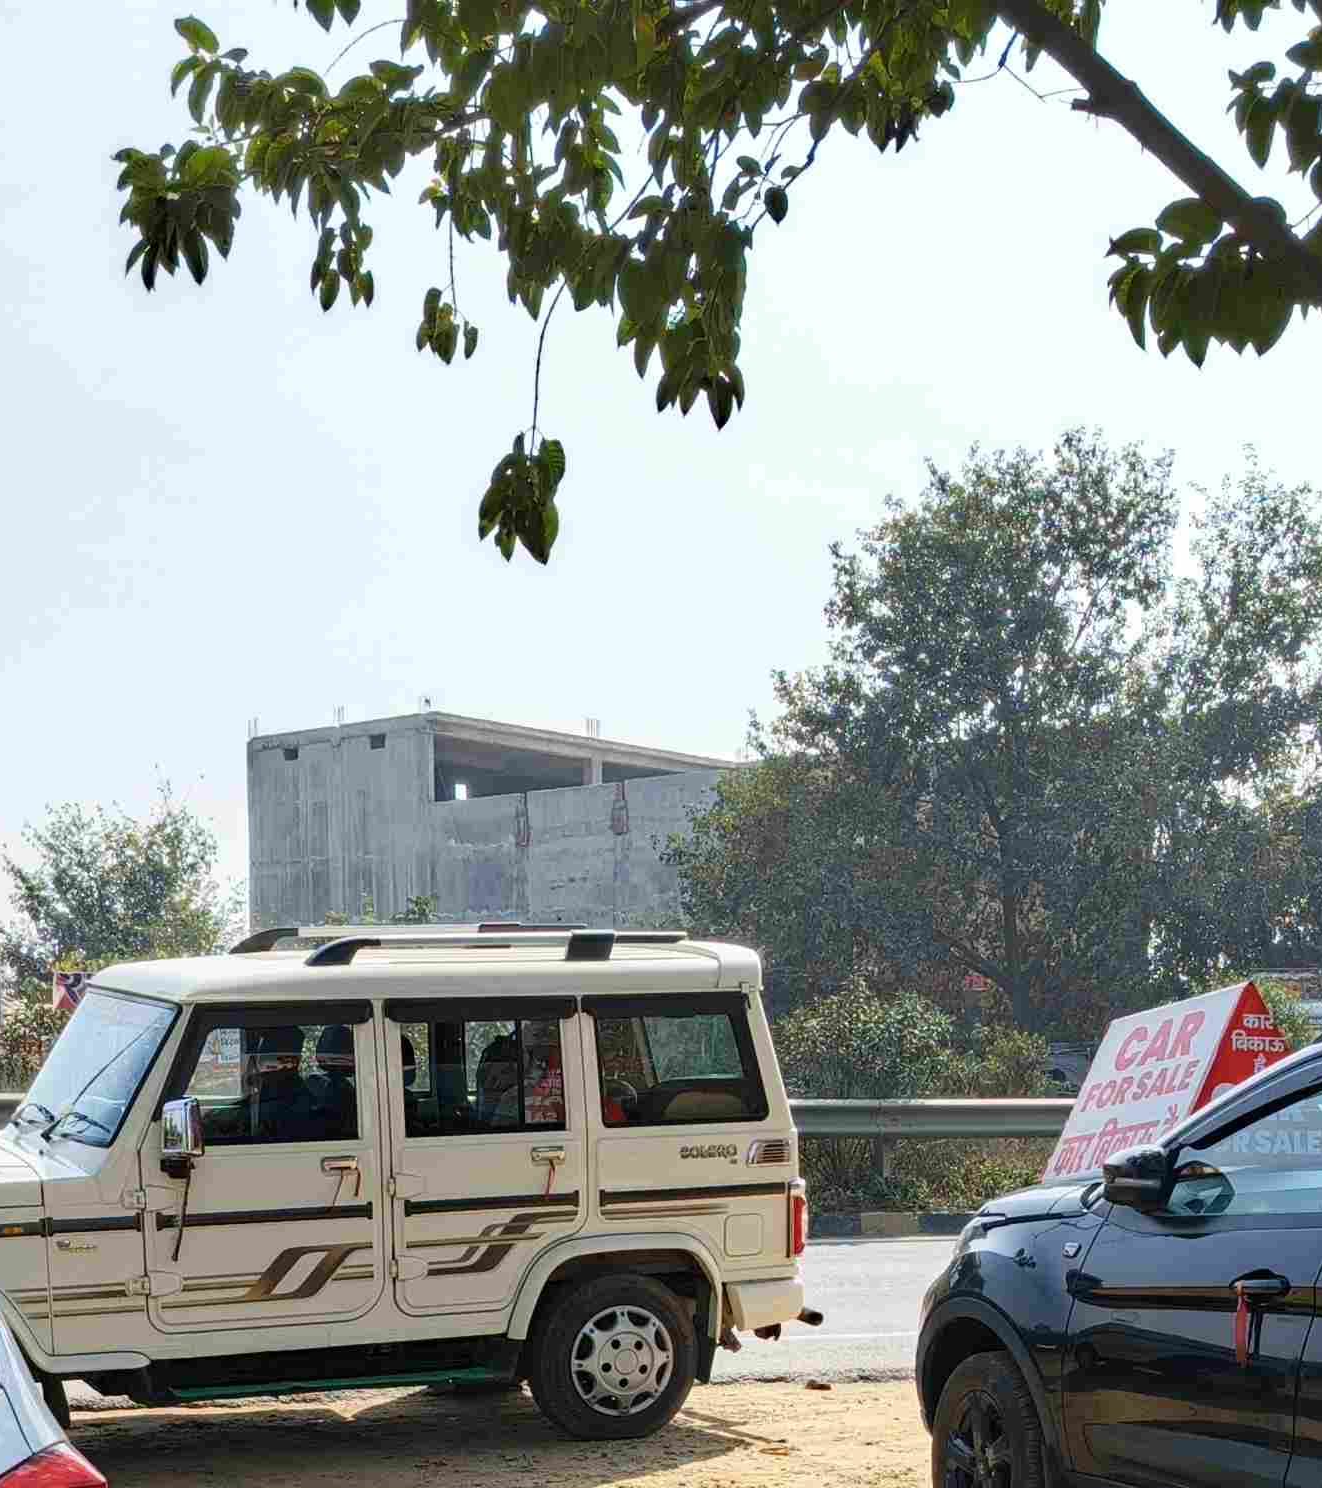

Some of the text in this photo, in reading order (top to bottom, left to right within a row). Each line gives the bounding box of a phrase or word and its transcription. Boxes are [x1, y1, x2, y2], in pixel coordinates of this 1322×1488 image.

[1114, 1009, 1206, 1072] CAR
[1081, 1060, 1201, 1113] FOR SALE
